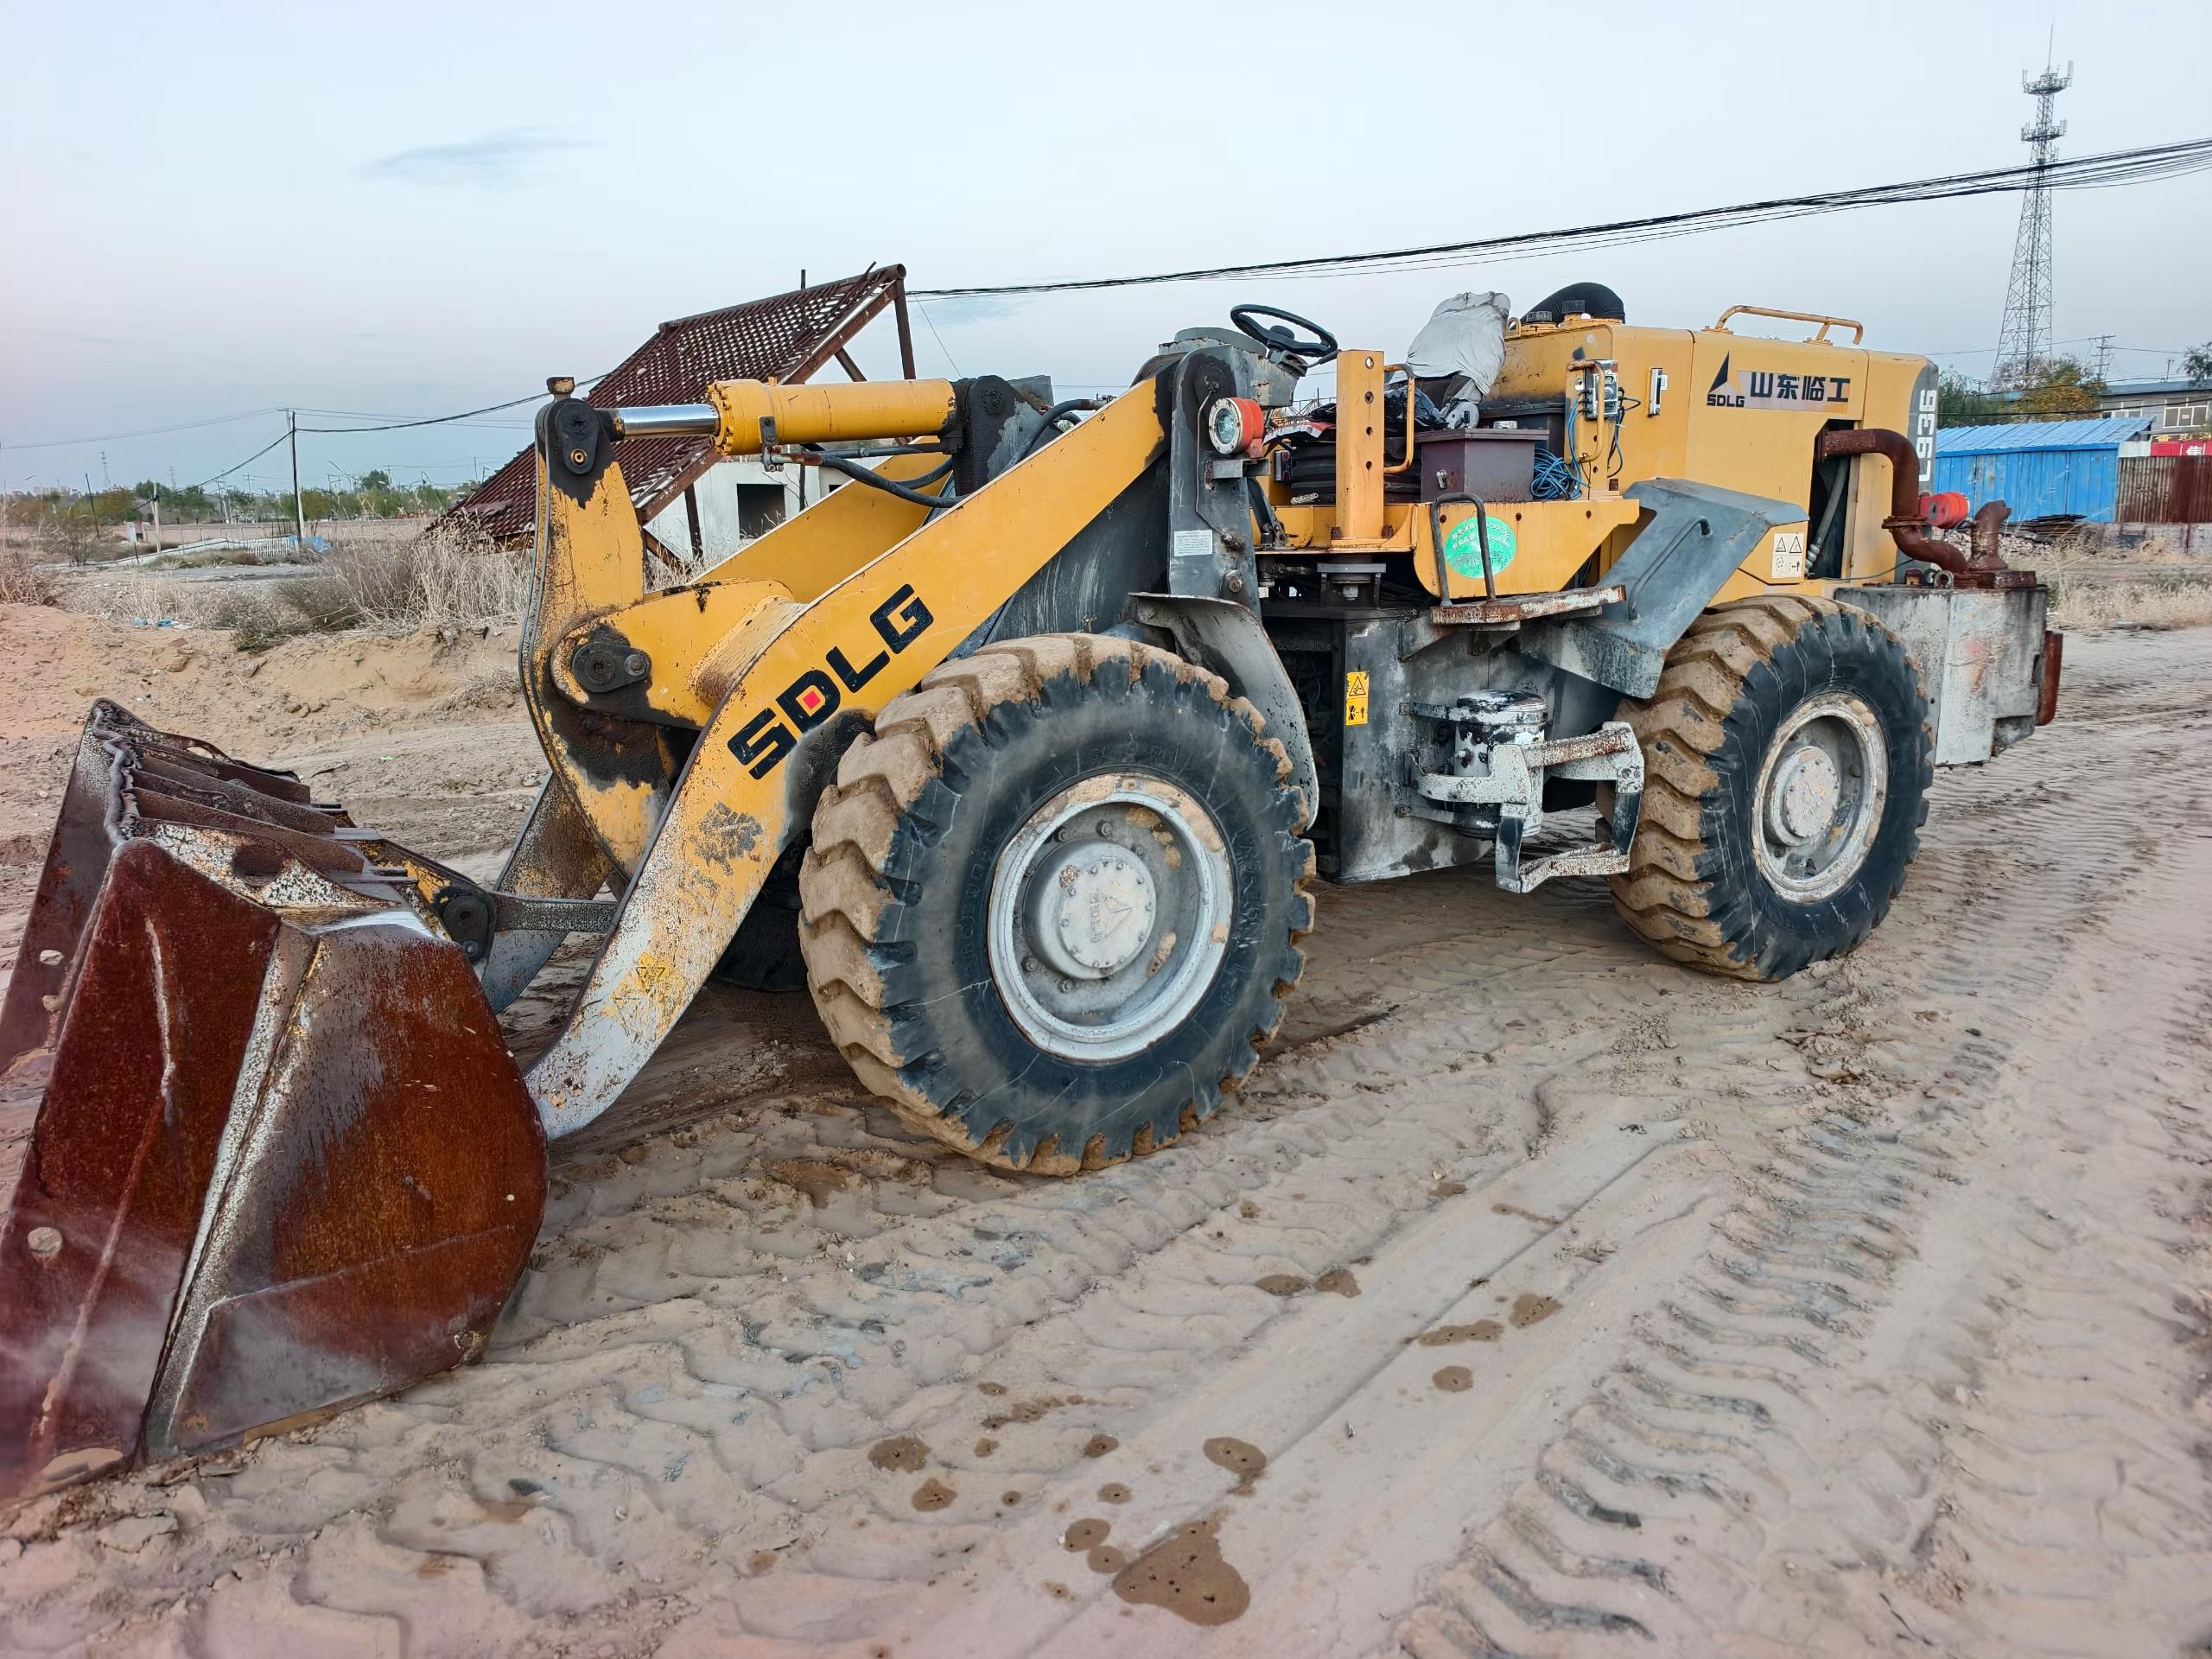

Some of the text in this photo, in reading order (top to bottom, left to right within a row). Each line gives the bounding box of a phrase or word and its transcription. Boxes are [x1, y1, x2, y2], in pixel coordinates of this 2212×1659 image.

[1707, 394, 1745, 407] SDLG
[1750, 372, 1851, 403] 山东临工
[1916, 389, 1937, 482] L936
[727, 583, 935, 780] SDLG
